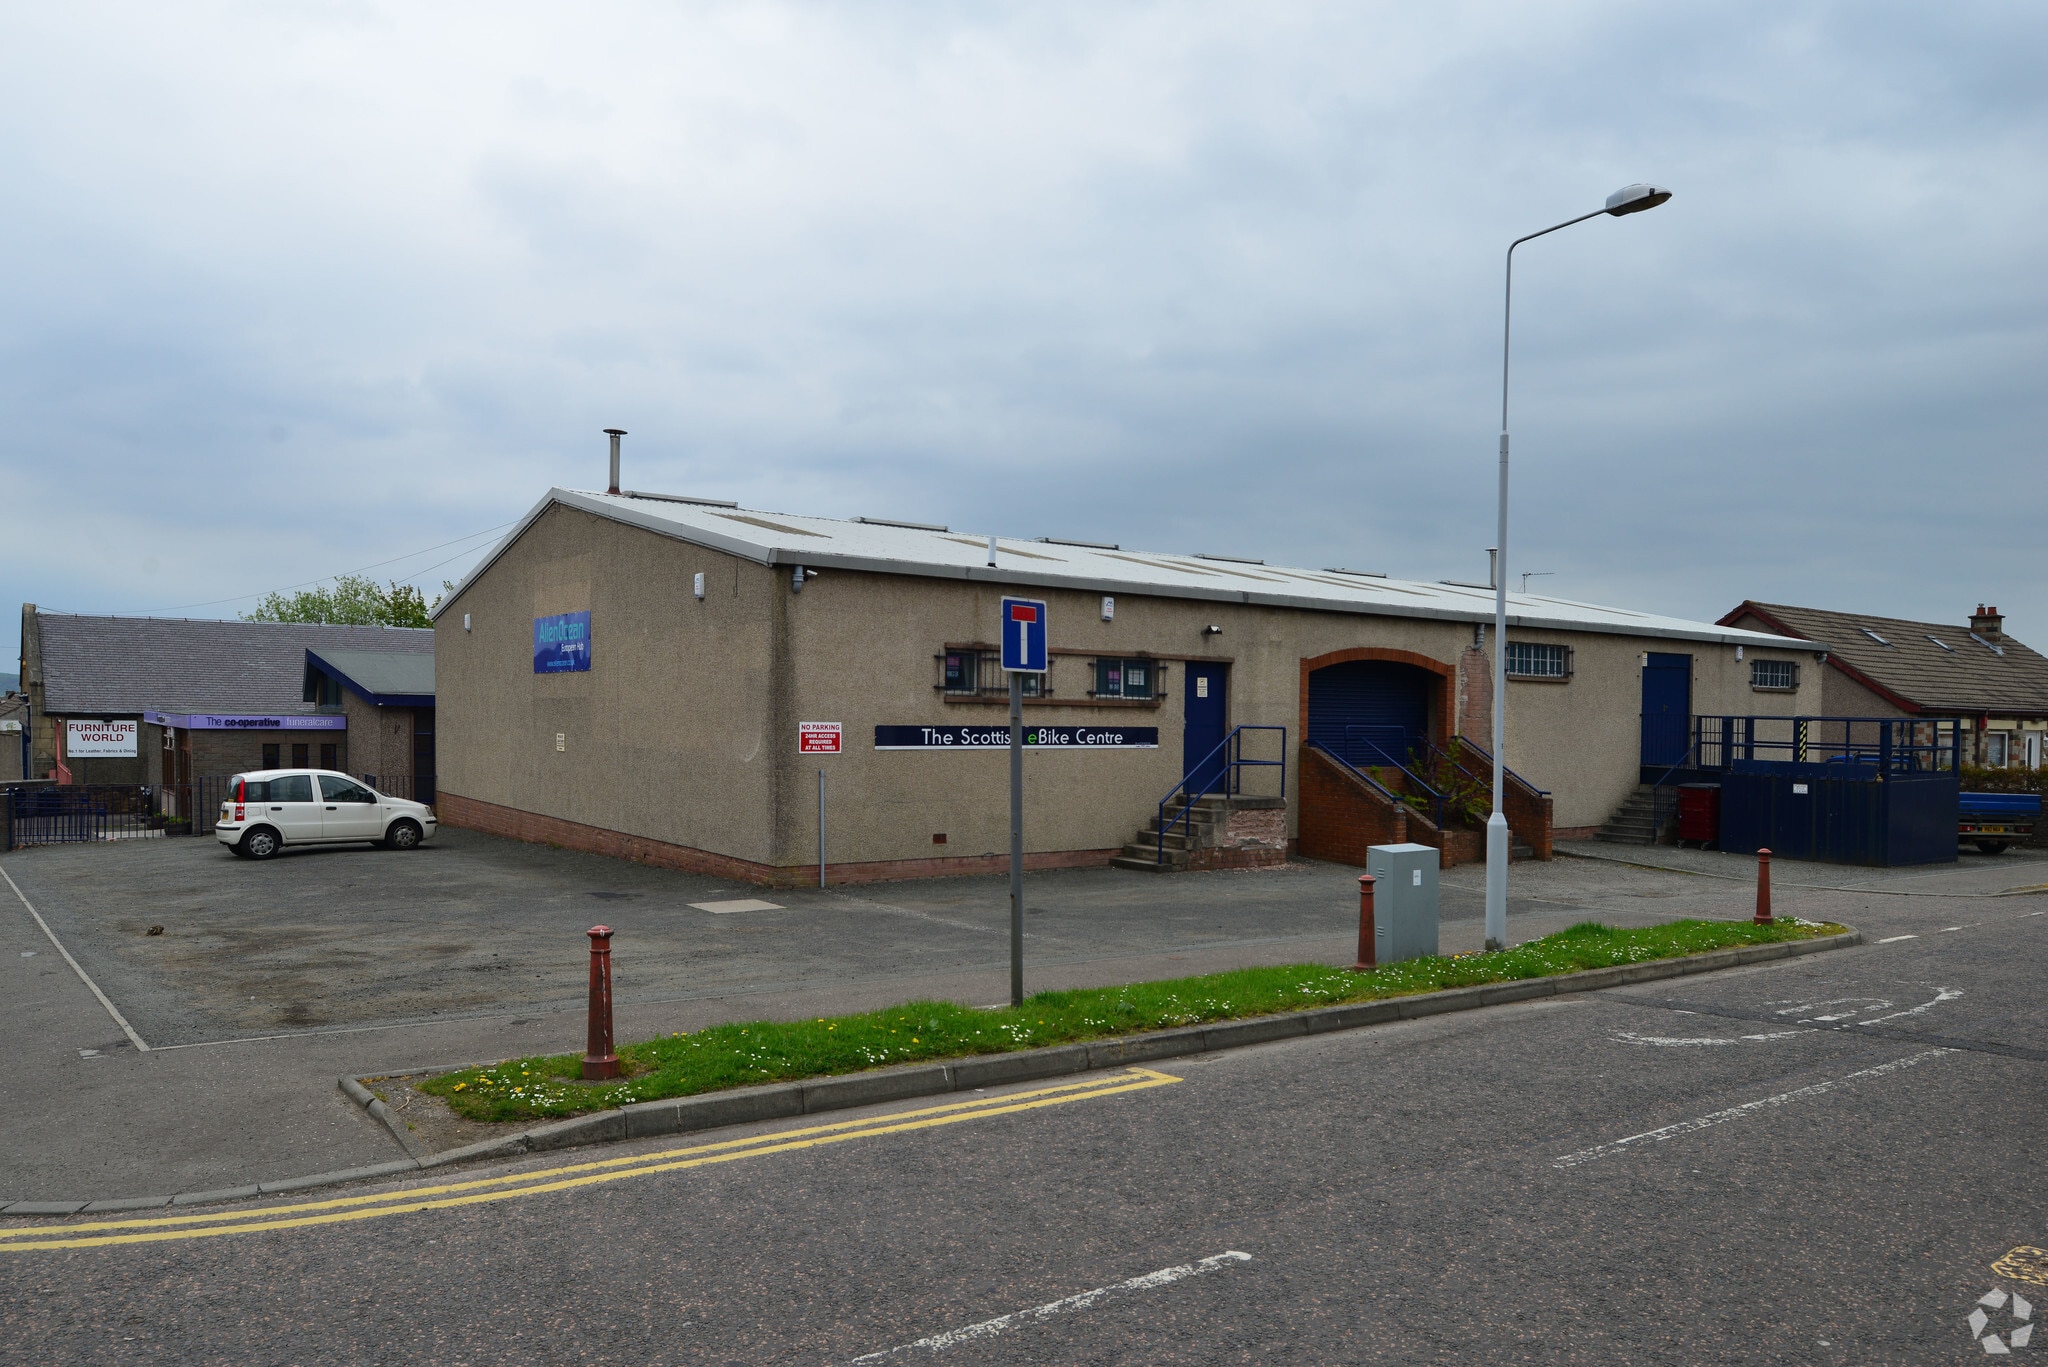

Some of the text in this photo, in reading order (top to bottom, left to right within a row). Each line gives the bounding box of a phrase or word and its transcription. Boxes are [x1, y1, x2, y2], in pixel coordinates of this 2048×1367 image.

[539, 620, 584, 643] AlienOcean
[69, 723, 135, 732] FURNITURE
[206, 716, 333, 729] The co-operative funeralcare
[81, 733, 124, 742] WORLD
[921, 728, 953, 745] The
[960, 728, 1011, 745] Scottis
[1027, 729, 1069, 744] eBike
[1076, 729, 1123, 744] Centre
